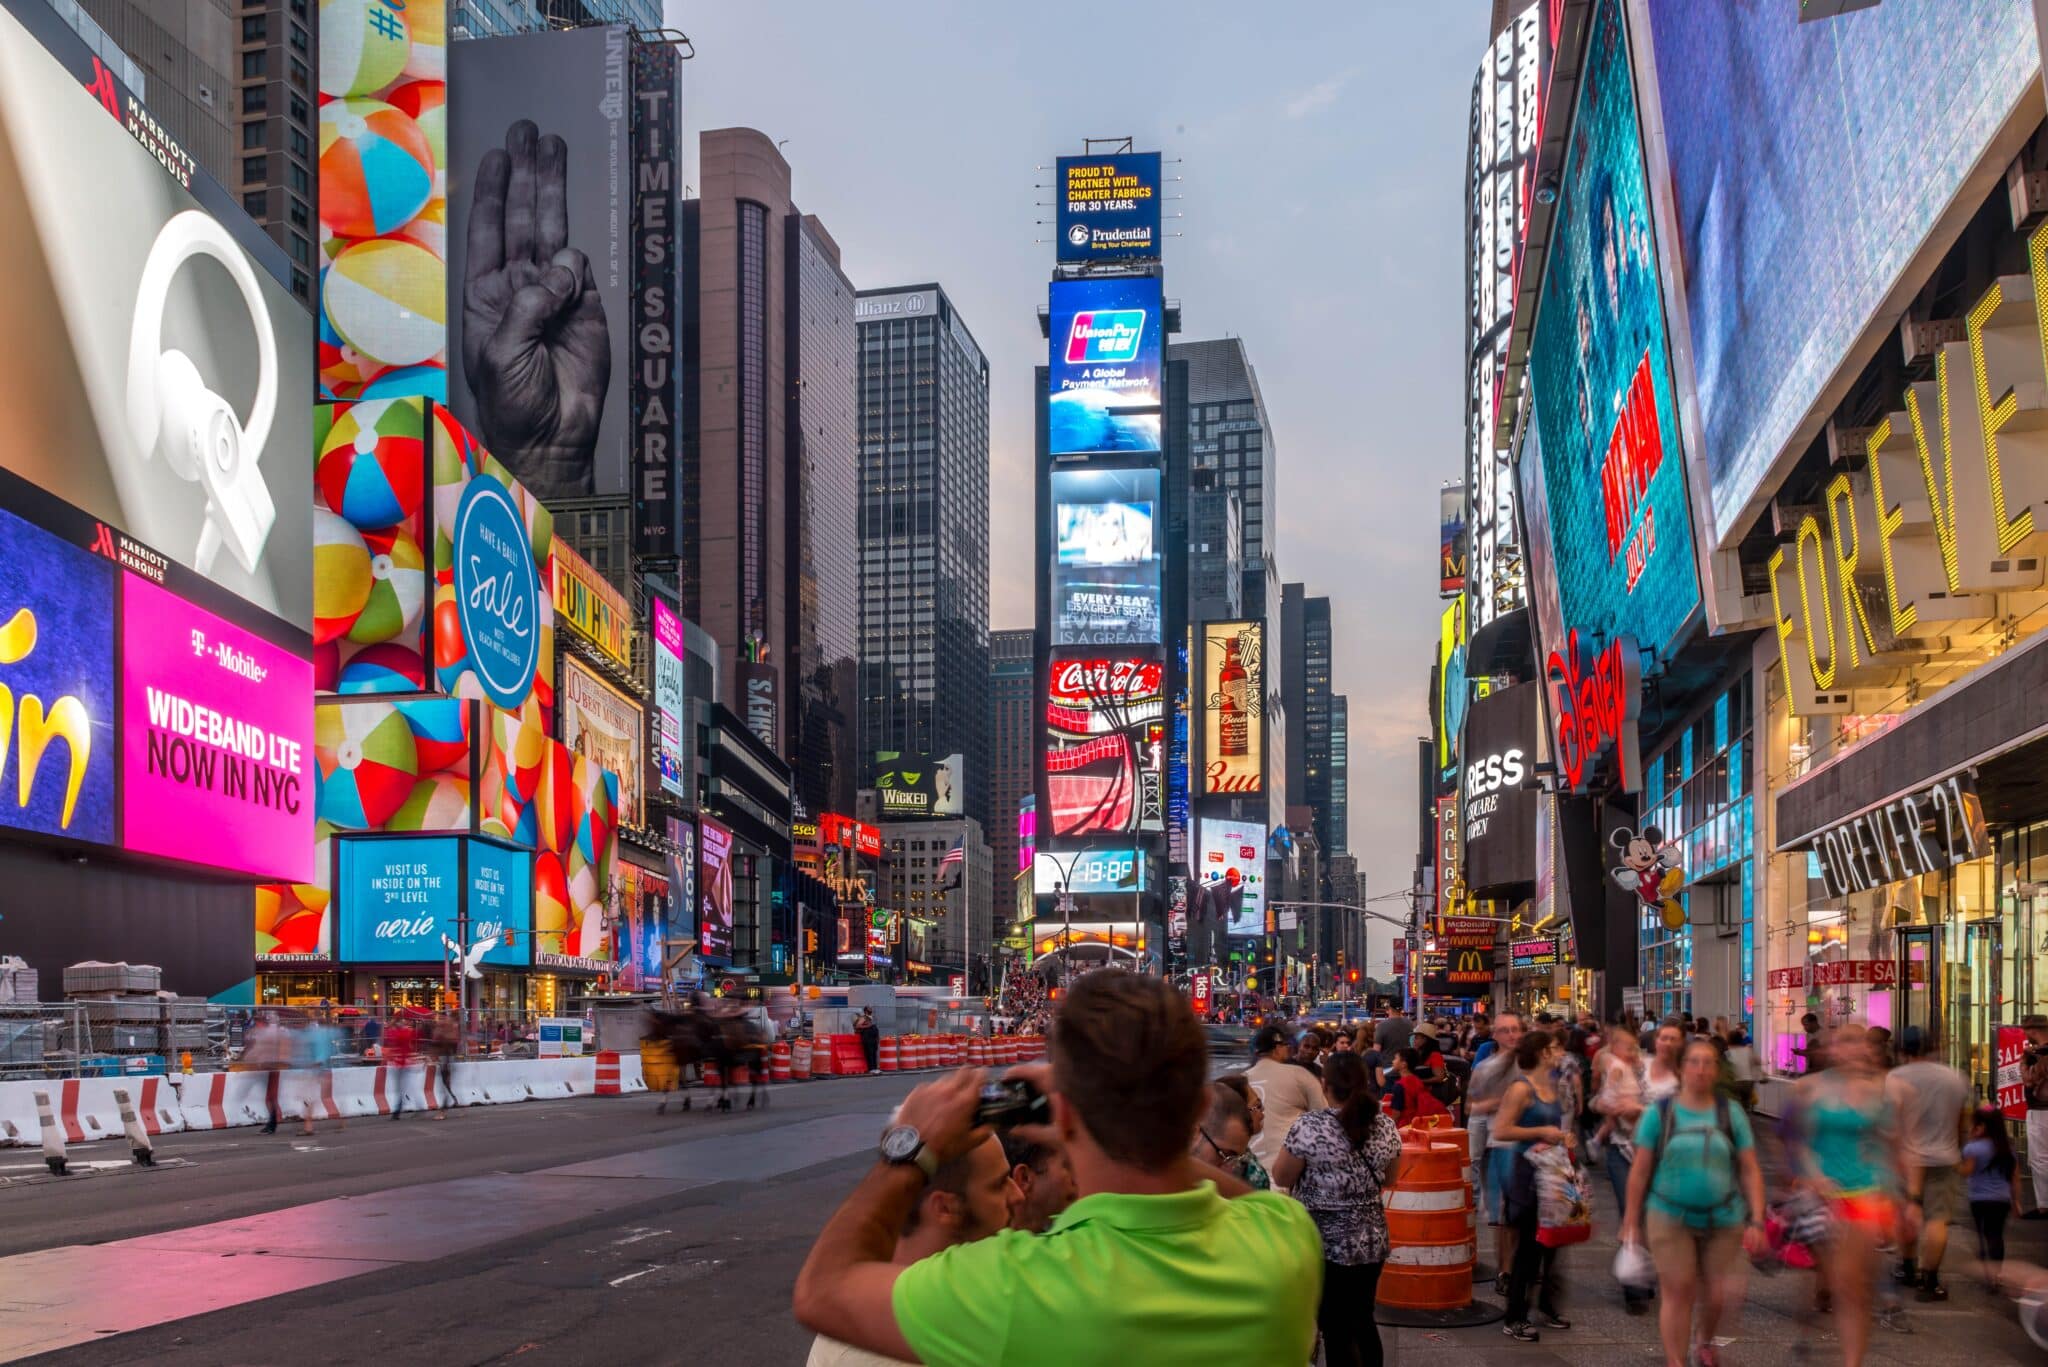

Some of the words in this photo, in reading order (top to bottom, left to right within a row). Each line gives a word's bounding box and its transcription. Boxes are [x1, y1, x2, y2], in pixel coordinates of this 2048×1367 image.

[128, 96, 197, 175] MARRIOTT
[127, 117, 190, 190] MARQUIS
[639, 91, 670, 265] TIMES
[1068, 167, 1100, 178] PROUD
[1102, 166, 1115, 176] TO
[1068, 178, 1111, 189] PARTNER
[1112, 176, 1138, 187] WITH
[1068, 189, 1111, 201] CHARTER
[1113, 187, 1152, 198] FABRICS
[1068, 202, 1086, 212] FOR
[1088, 201, 1101, 211] 30
[1103, 199, 1137, 211] YEARS.
[1092, 227, 1151, 241] Prudential
[856, 302, 901, 316] llianz
[1074, 323, 1139, 339] UnionPay
[1082, 369, 1091, 378] A
[1093, 368, 1126, 378] Global
[1062, 378, 1106, 390] Payment
[1107, 376, 1150, 388] Network
[639, 287, 671, 500] SQUARE
[479, 522, 496, 547] HAVE
[643, 525, 666, 535] NYC
[120, 537, 169, 570] MARRIOTT
[120, 551, 164, 582] MARQUIS
[470, 554, 529, 637] Sale
[1073, 592, 1112, 604] EVERY
[1116, 595, 1151, 608] SEAT
[559, 565, 587, 628] FUN
[592, 593, 626, 662] HOME
[1091, 605, 1121, 616] GREAT
[1123, 606, 1149, 618] SEAT
[1078, 632, 1091, 644] A
[1094, 632, 1147, 645] GREAT
[567, 666, 581, 703] 10
[582, 692, 601, 717] BEST
[1548, 626, 1634, 795] Disney
[146, 687, 265, 762] WIDEBAND
[269, 734, 301, 774] LTE
[147, 728, 217, 791] NOW
[223, 753, 247, 801] IN
[253, 766, 301, 815] NYC
[1812, 796, 1936, 900] FOREVER
[1932, 775, 1978, 867] 21
[1240, 848, 1253, 857] Gift
[1444, 809, 1456, 900] PALAC
[385, 864, 410, 876] VISIT
[413, 863, 428, 875] US
[685, 831, 694, 896] SOLO
[480, 867, 493, 878] VISIT
[493, 870, 500, 881] US
[371, 878, 405, 889] INSIDE
[407, 877, 421, 889] ON
[424, 877, 441, 889] THE
[475, 879, 490, 893] INSIDE
[490, 882, 498, 894] ON
[497, 883, 505, 895] THE
[384, 892, 399, 904] 3RD
[401, 892, 428, 903] LEVEL
[487, 895, 500, 907] LEVEL
[685, 899, 694, 913] 2
[375, 911, 435, 939] aerie
[476, 915, 503, 938] aerie
[274, 953, 330, 962] OUTFITTERS
[587, 958, 621, 972] OUTFITTRS
[1196, 975, 1208, 999] tkts
[1997, 1039, 2030, 1067] SALE
